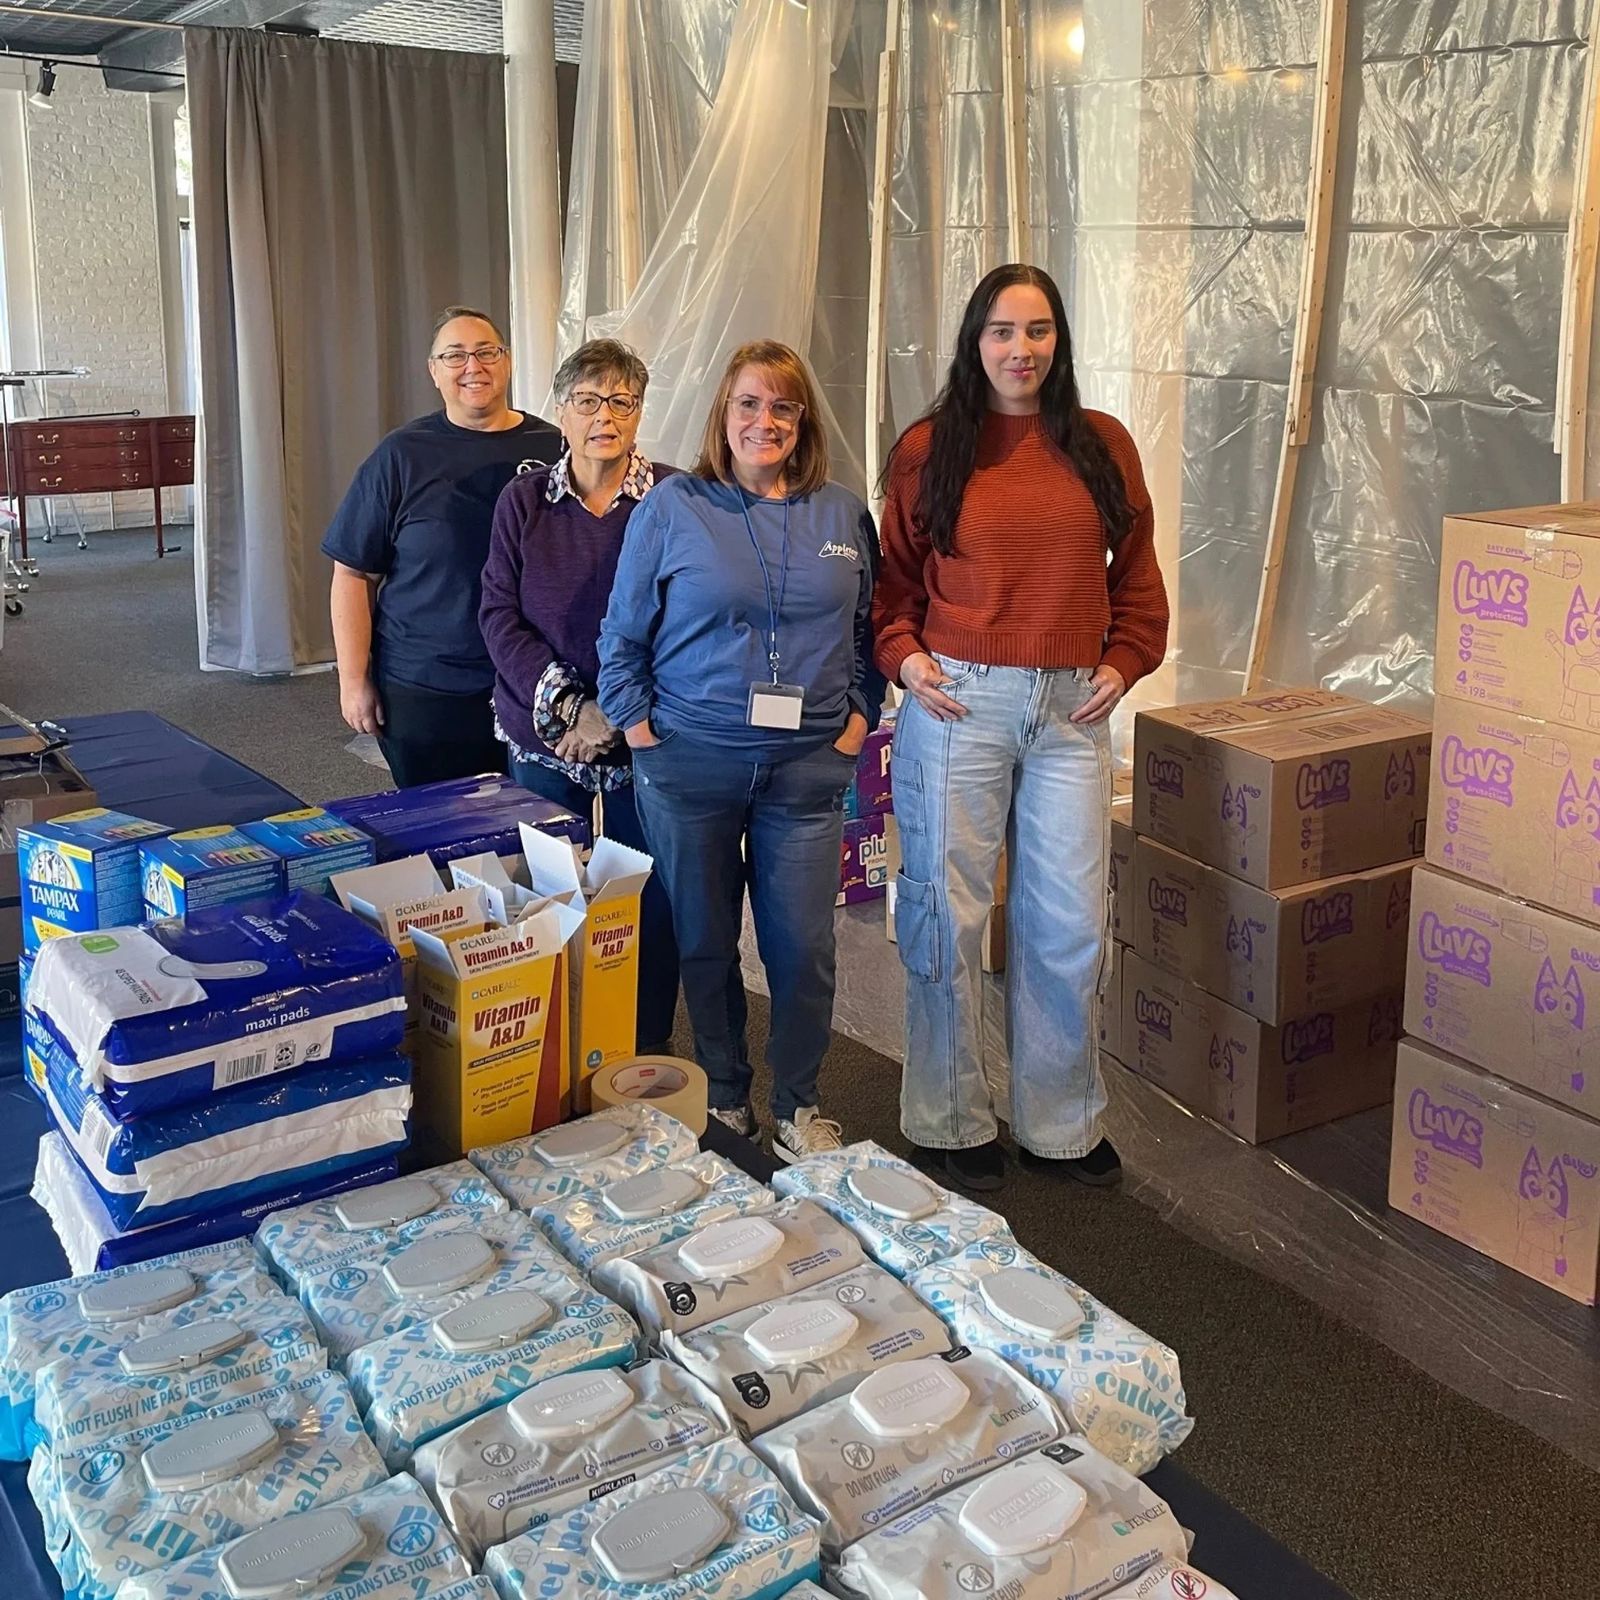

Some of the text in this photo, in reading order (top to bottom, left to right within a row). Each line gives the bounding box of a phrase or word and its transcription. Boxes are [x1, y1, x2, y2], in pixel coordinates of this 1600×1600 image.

[1457, 670, 1467, 684] 4
[1469, 686, 1486, 698] 198
[1456, 858, 1472, 871] 198
[29, 884, 79, 912] TAMPAX
[397, 911, 440, 934] Vitamin
[442, 905, 464, 926] A&D
[592, 924, 634, 946] Vitamin
[464, 936, 534, 968] Vitamin A&D
[601, 940, 624, 958] A&D
[245, 1006, 311, 1033] maxi pads
[422, 991, 456, 1024] Vitamin
[474, 996, 541, 1033] Vitamin
[430, 1013, 449, 1035] A&D
[489, 1020, 526, 1049] A&D
[402, 1391, 426, 1409] NOT
[427, 1375, 462, 1400] FLUSH
[470, 1362, 485, 1378] NE
[485, 1354, 506, 1372] PAS
[507, 1342, 537, 1363] JETER
[538, 1332, 564, 1350] DANS
[564, 1325, 584, 1341] LES
[65, 1419, 91, 1440] NOT
[94, 1406, 134, 1429] FLUSH
[141, 1394, 158, 1413] NE
[159, 1386, 183, 1408] PAS
[185, 1376, 219, 1400] JETER
[219, 1364, 250, 1386] DANS
[251, 1356, 272, 1377] LES
[1001, 1397, 1039, 1422] TENCEL
[592, 1474, 635, 1499] KIRKLAND
[846, 1463, 902, 1498] DO NOT FLUSH
[529, 1512, 549, 1527] 100
[1125, 1504, 1166, 1530] TENCEL
[720, 1550, 753, 1573] DANS
[754, 1540, 773, 1557] LES
[344, 1576, 384, 1600] DANS
[384, 1567, 408, 1588] LES
